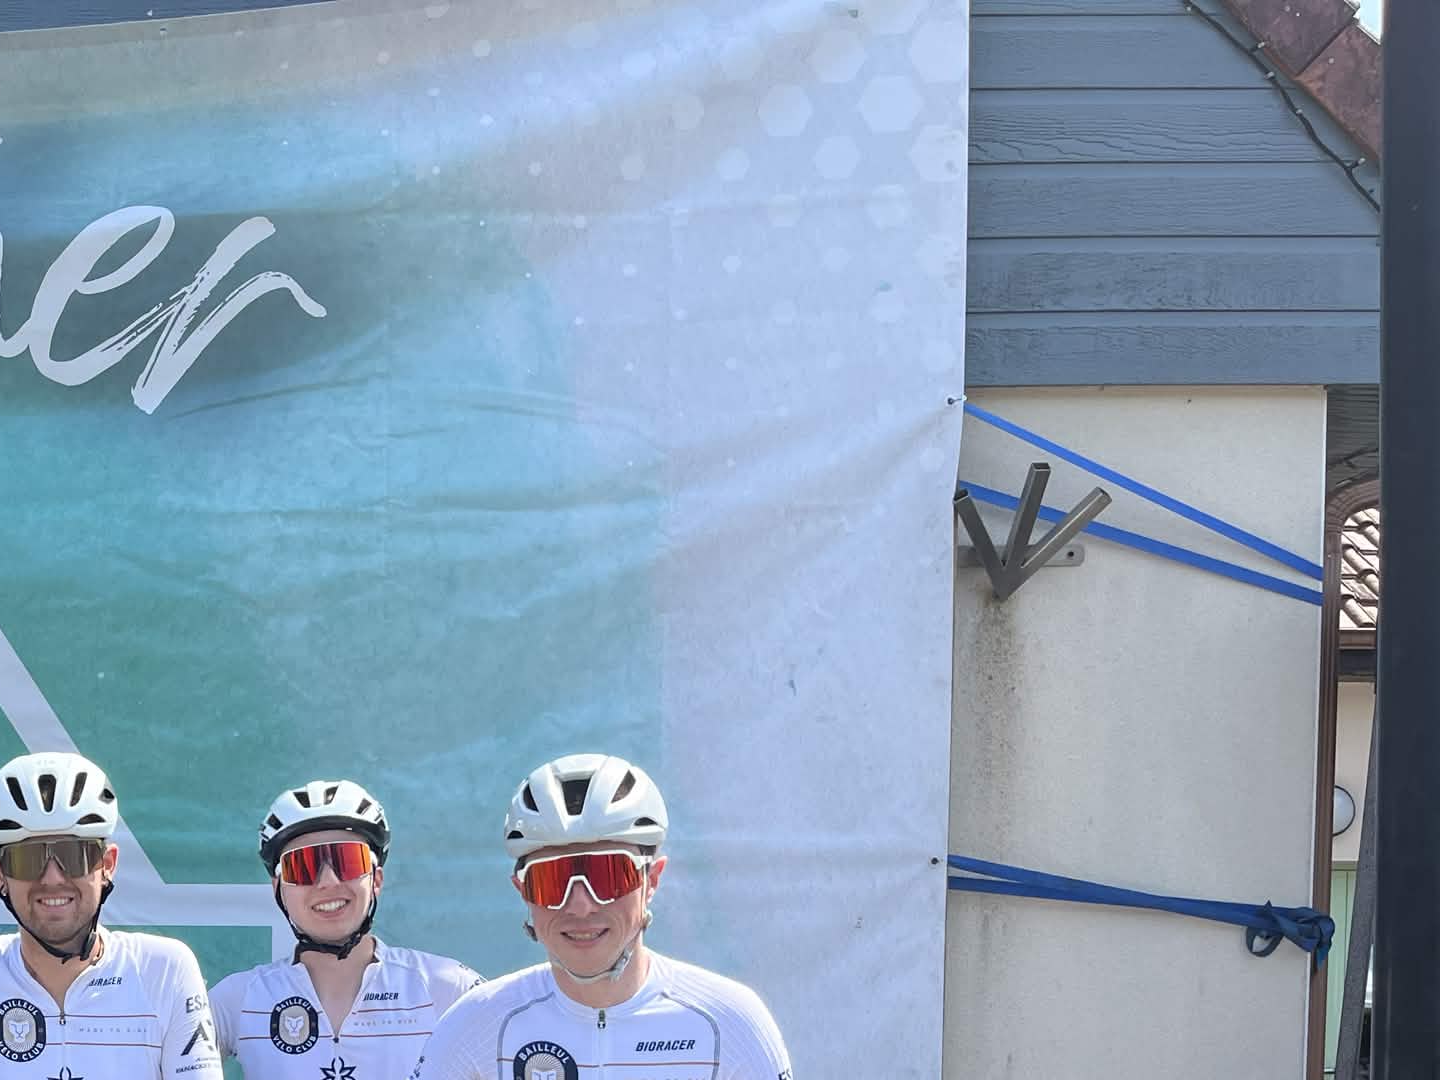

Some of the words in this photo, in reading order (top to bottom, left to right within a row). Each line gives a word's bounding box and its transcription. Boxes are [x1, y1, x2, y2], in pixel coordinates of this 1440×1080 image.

[276, 998, 312, 1013] BAILLEUL
[21, 1041, 44, 1062] CLUB
[272, 1035, 294, 1053] VELO
[295, 1035, 317, 1053] CLUB
[518, 1041, 571, 1065] BAILLEUL
[635, 1039, 697, 1052] BIORACER
